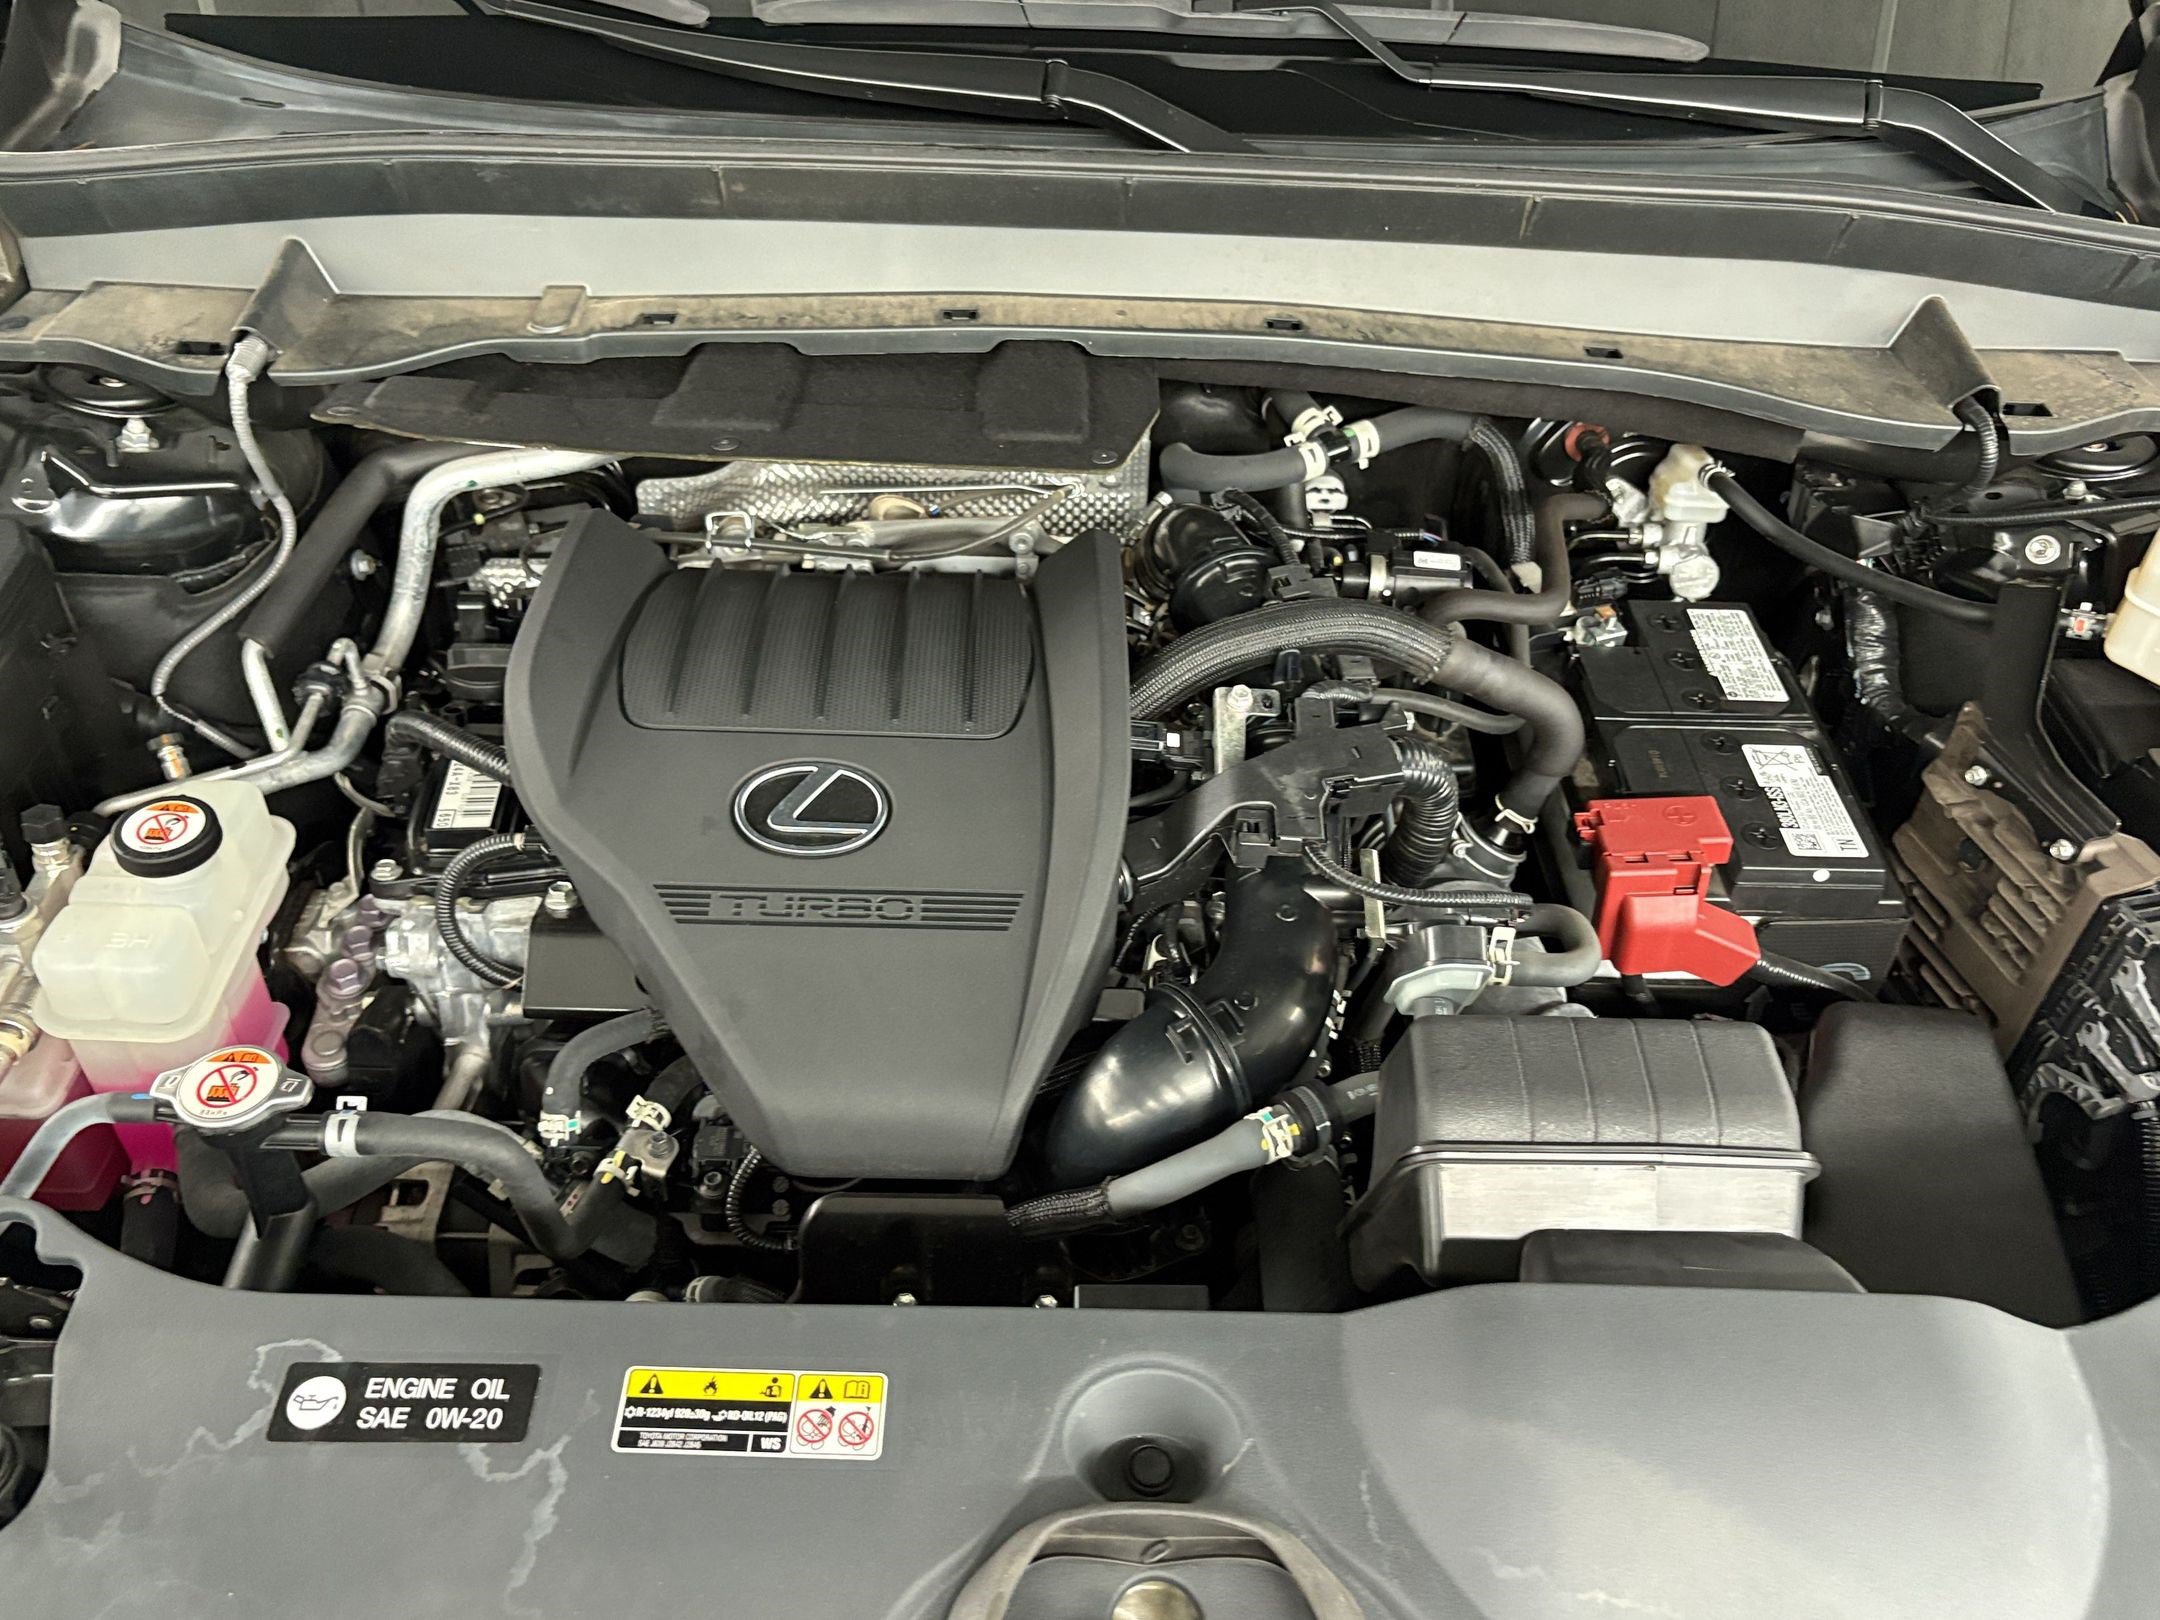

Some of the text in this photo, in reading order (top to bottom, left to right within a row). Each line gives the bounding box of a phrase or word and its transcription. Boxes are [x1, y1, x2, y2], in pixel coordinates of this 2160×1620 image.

[1835, 838, 1858, 851] TN
[717, 894, 914, 921] TURBO
[364, 1377, 511, 1400] ENGINE OIL
[355, 1406, 504, 1430] SAE 0W-20
[760, 1437, 781, 1450] WS
